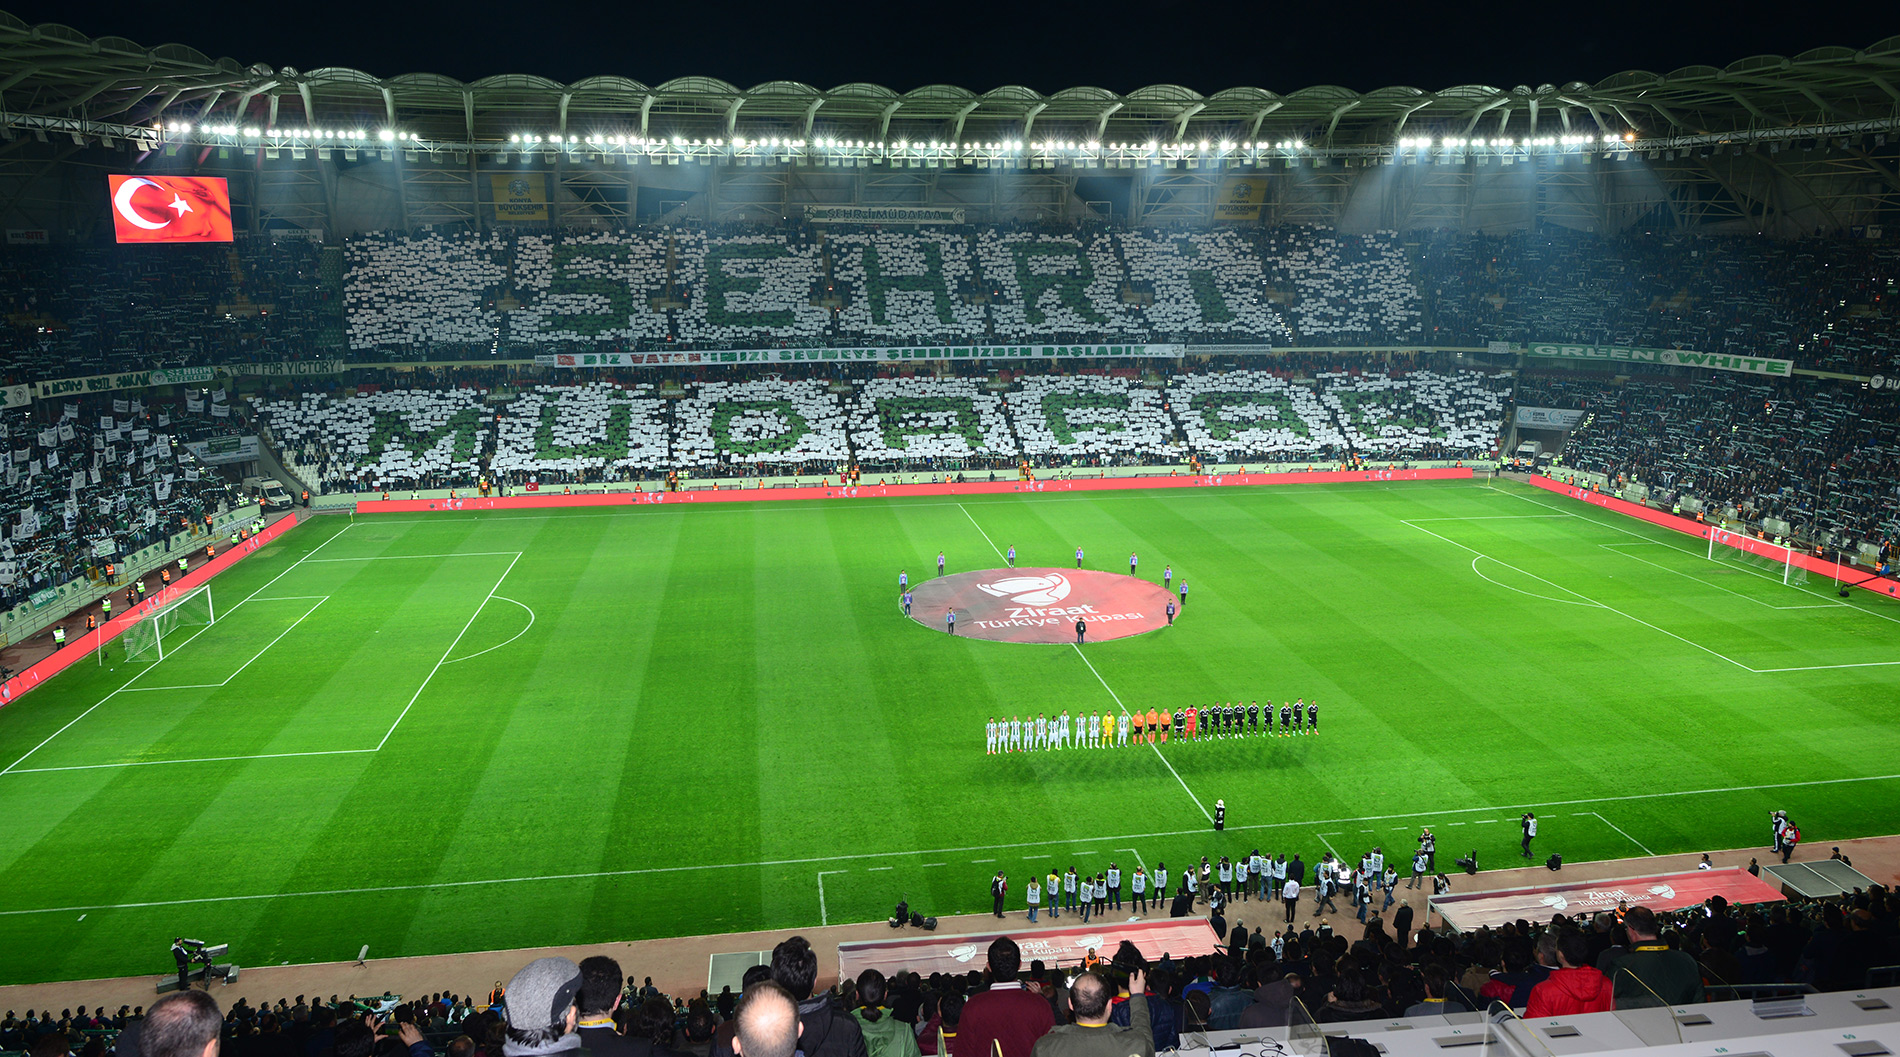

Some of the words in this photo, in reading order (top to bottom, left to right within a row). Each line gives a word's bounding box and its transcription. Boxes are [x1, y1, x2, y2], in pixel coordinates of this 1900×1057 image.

[875, 208, 943, 220] MÜDAFAA
[778, 349, 878, 361] SEVMEYE
[1533, 345, 1655, 361] GREEN
[1674, 352, 1788, 374] WHITE
[228, 363, 258, 376] FIGHT
[262, 363, 283, 375] FOR
[1004, 603, 1100, 620] Ziraat
[974, 616, 1060, 629] Türkiye
[1066, 612, 1145, 624] Kupası
[1576, 897, 1614, 906] Türkiye
[1617, 894, 1652, 903] Kupası
[1583, 889, 1628, 899] Ziraat
[1017, 940, 1051, 950] raat
[1032, 946, 1072, 955] Kupası
